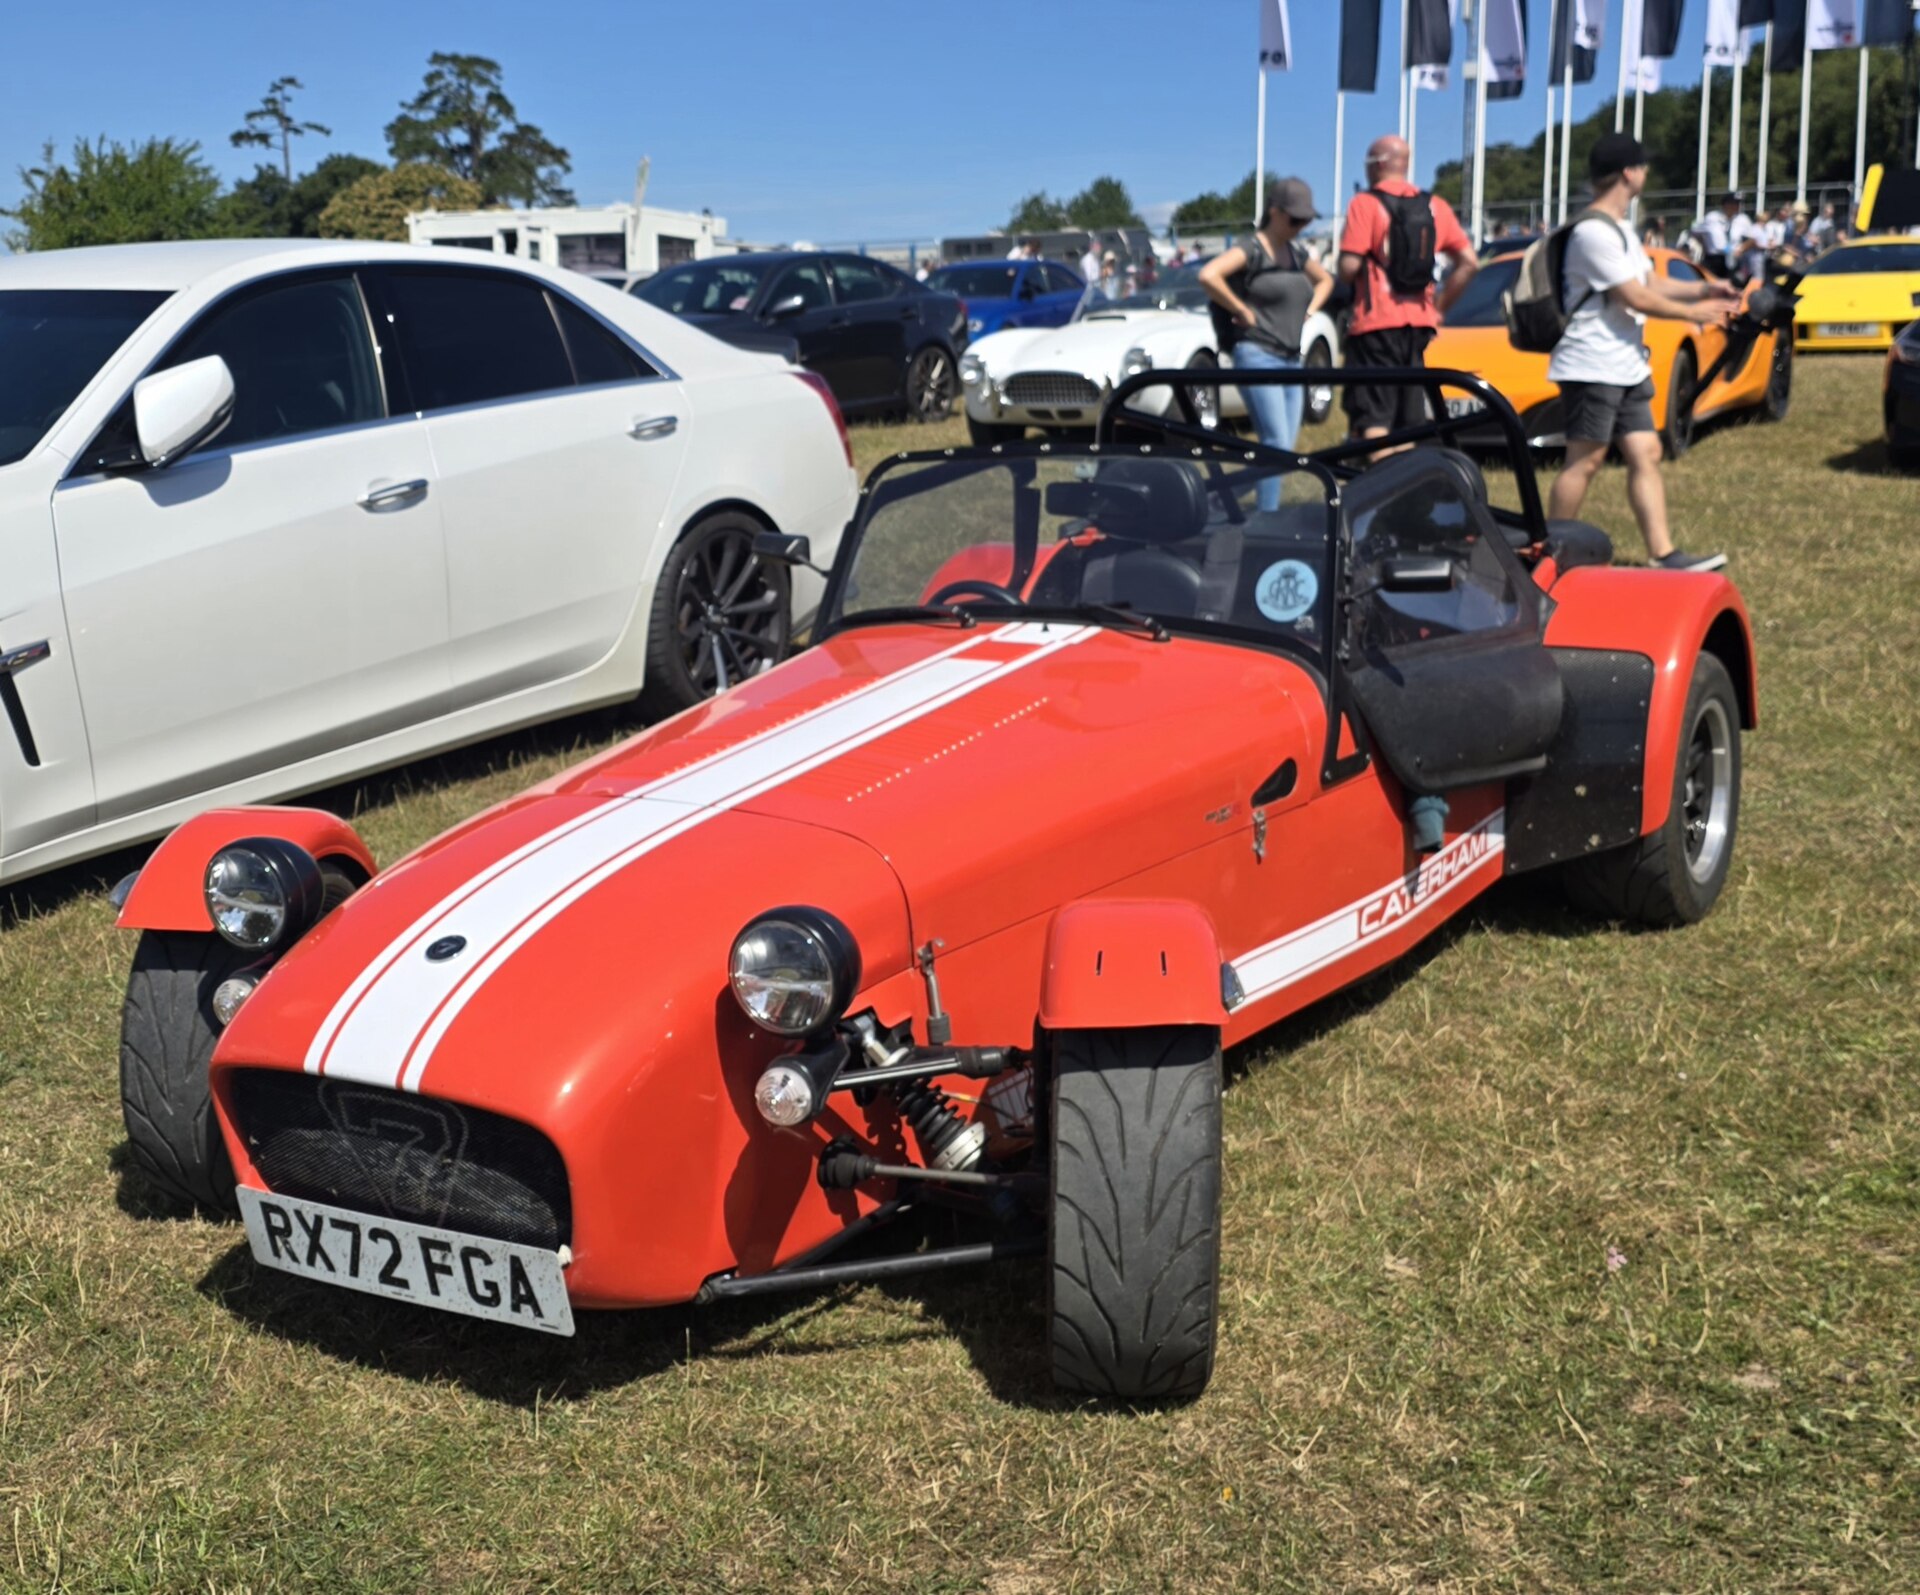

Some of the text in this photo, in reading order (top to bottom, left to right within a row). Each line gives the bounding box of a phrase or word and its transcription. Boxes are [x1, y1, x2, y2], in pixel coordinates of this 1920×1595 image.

[1361, 828, 1487, 935] CATERHAM
[260, 1201, 544, 1320] RX72 FGA
